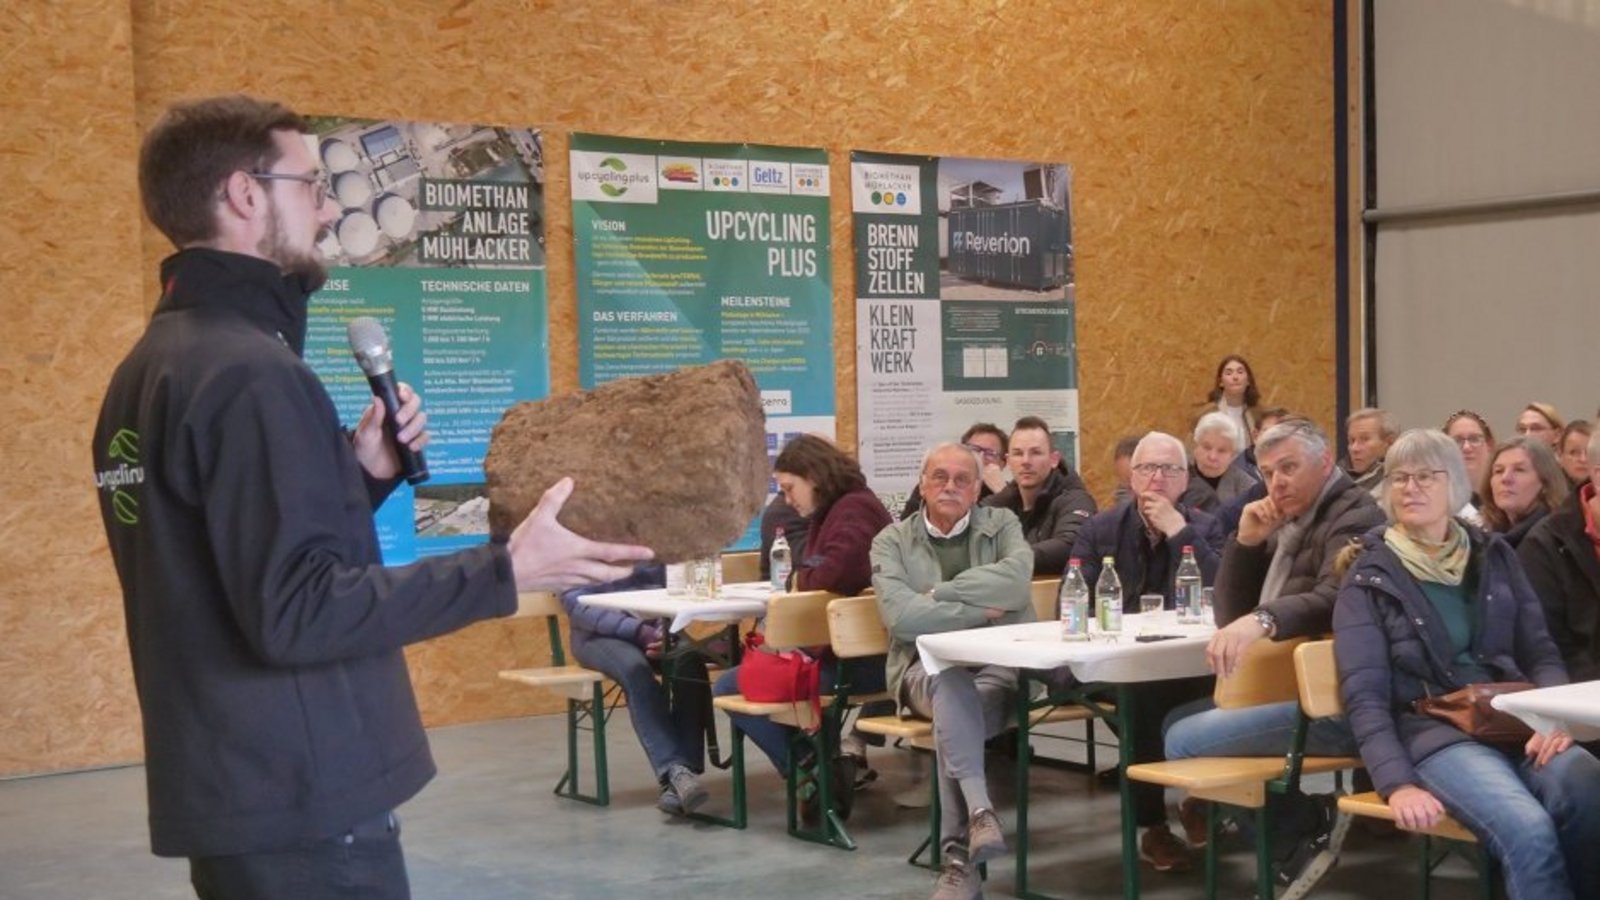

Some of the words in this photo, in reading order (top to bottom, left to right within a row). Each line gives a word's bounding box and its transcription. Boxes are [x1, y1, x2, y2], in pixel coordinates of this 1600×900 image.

[754, 166, 783, 184] Geltz
[425, 183, 529, 209] BIOMETHAN
[462, 211, 529, 235] ANLAGE
[592, 219, 626, 231] VISION
[706, 210, 816, 242] UPCYCLING
[423, 232, 530, 260] MÜHLACKER
[868, 223, 919, 247] BRENN
[965, 231, 1031, 255] Reverion
[768, 247, 817, 277] PLUS
[868, 248, 914, 270] STOFF
[421, 280, 492, 293] TECHNISCHE
[494, 281, 530, 293] DATEN
[868, 271, 925, 295] ZELLEN
[721, 296, 792, 308] MEILENSTEINE
[593, 311, 615, 322] DAS
[617, 311, 679, 322] VERFAHREN
[869, 304, 914, 327] KLEIN
[870, 328, 918, 350] KRAFT
[870, 351, 914, 374] WERK
